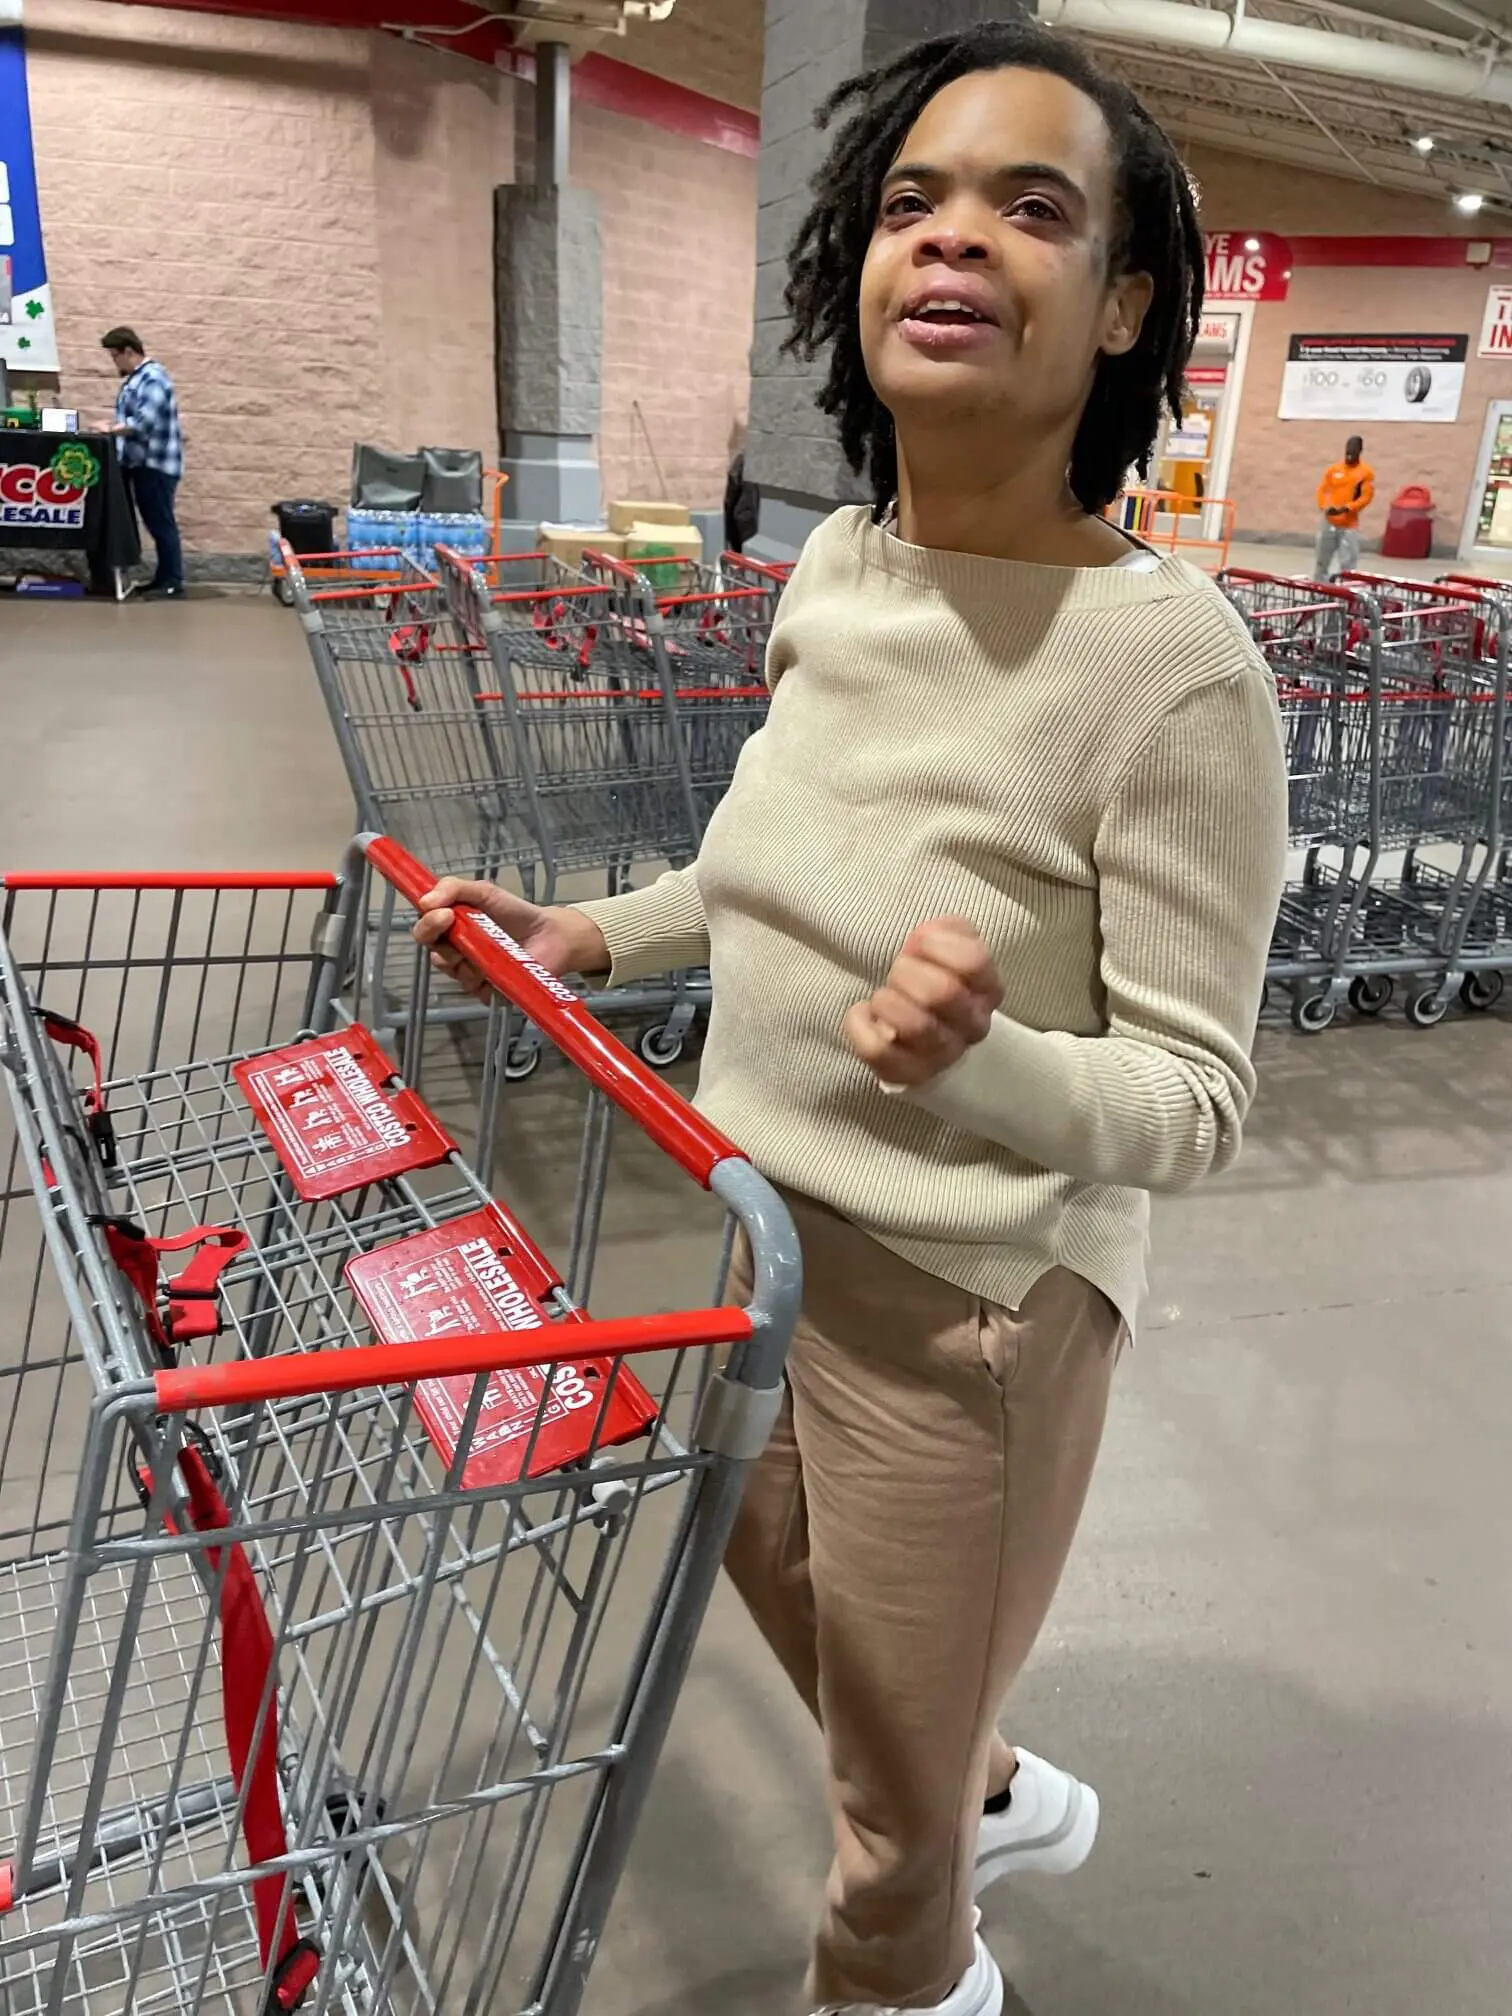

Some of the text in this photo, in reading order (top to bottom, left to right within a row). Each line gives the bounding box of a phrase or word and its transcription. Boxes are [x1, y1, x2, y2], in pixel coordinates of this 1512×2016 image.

[466, 911, 578, 1002] COSTCO WHOLESALE
[325, 1046, 380, 1104] WHOLESALE
[365, 1101, 412, 1147] COSTCO
[461, 1238, 593, 1410] COS WHOLESALE
